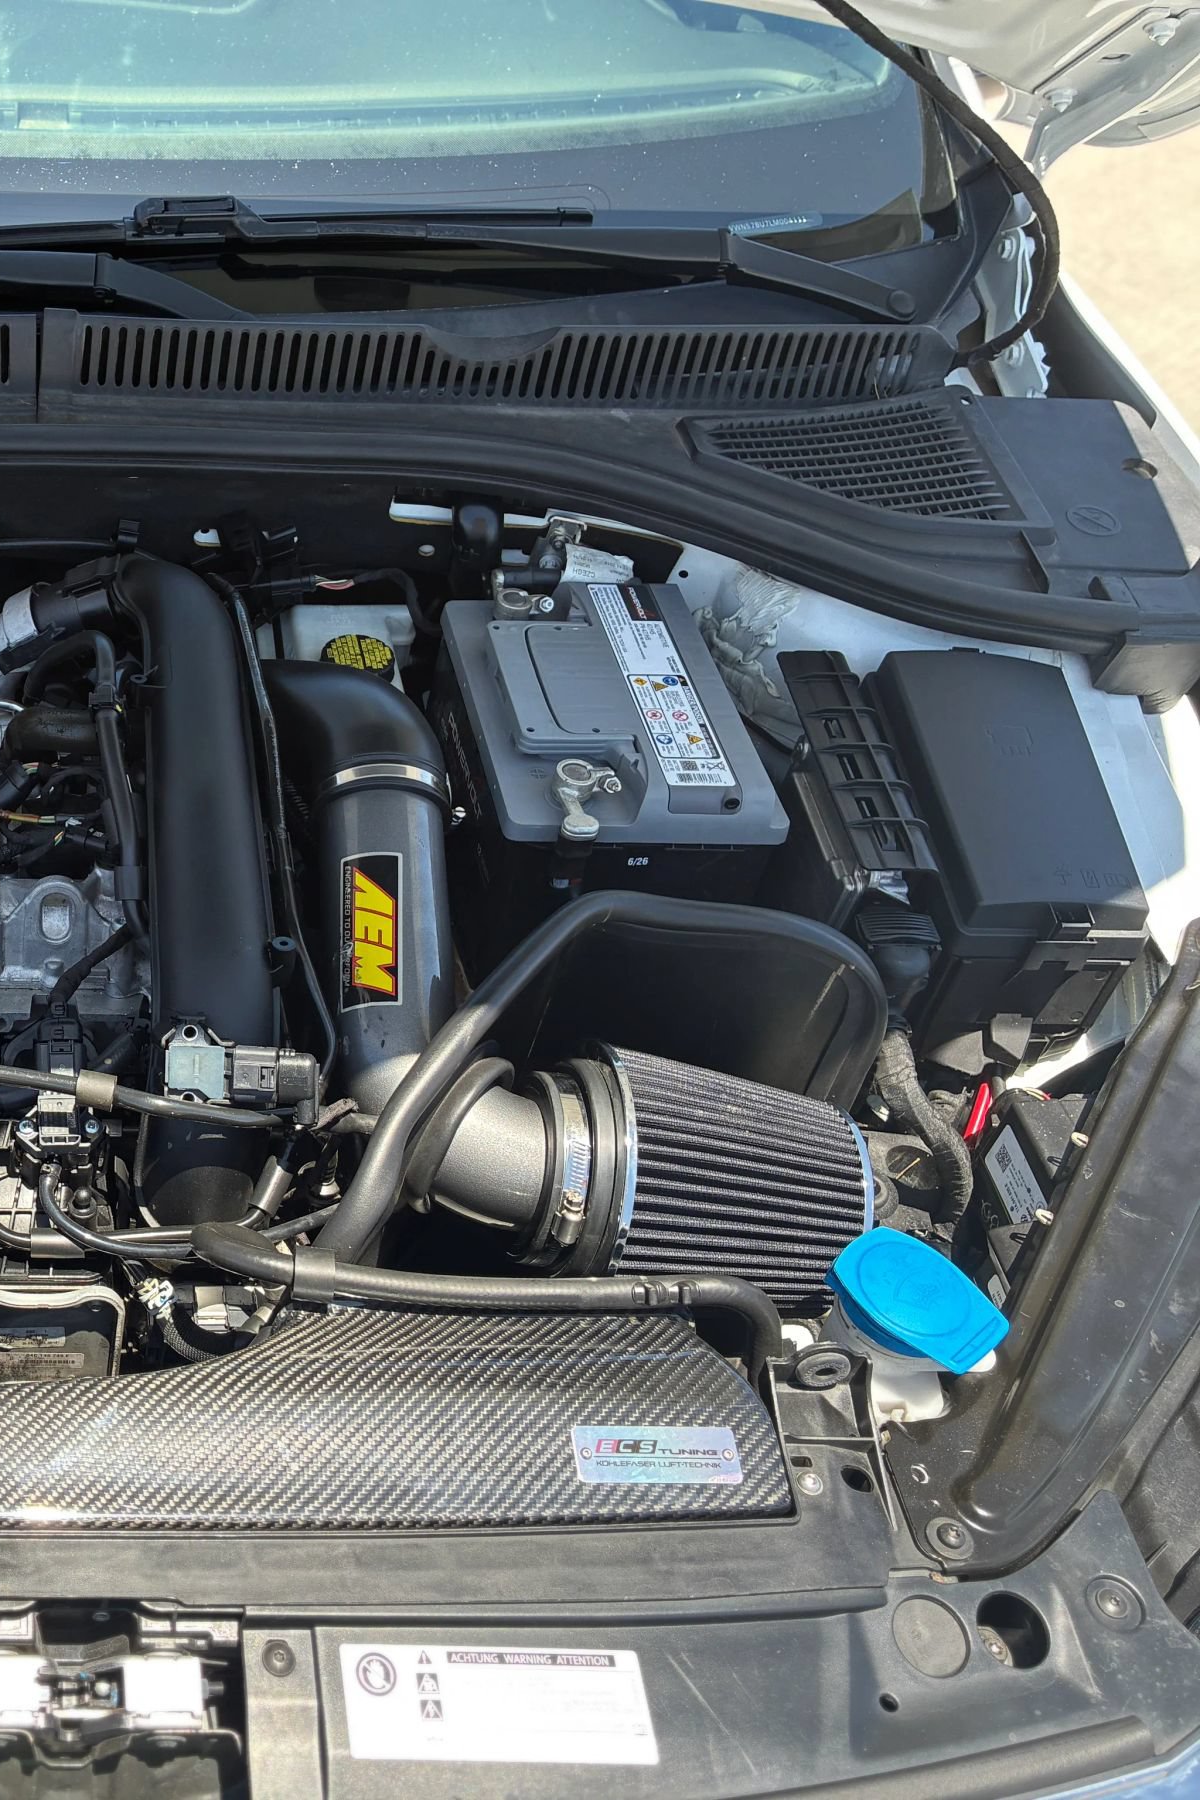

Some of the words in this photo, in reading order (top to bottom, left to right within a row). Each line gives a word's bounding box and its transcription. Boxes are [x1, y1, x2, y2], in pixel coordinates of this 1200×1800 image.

[627, 857, 649, 867] 6/26
[344, 865, 352, 916] ENGINEERED
[344, 917, 352, 930] TO
[353, 868, 395, 995] AEM
[344, 931, 352, 987] OURFORM
[597, 1440, 656, 1454] ECS
[659, 1448, 718, 1456] TUNING
[451, 1652, 498, 1663] ACHTUNG
[504, 1654, 552, 1664] WARNING
[557, 1655, 610, 1666] ATTENTION
